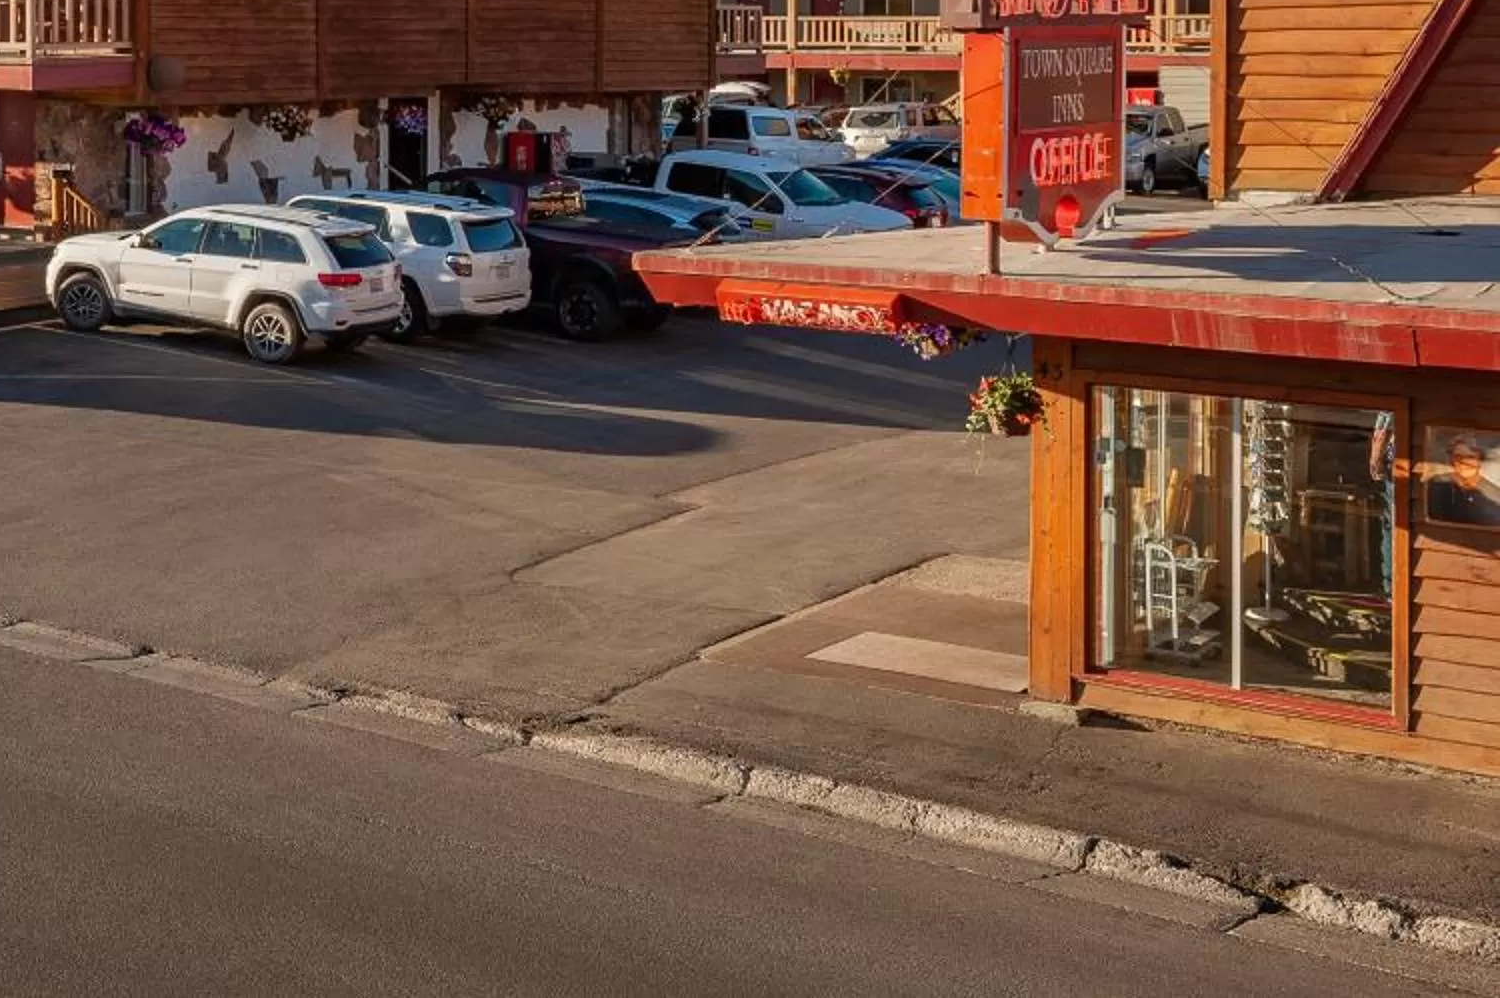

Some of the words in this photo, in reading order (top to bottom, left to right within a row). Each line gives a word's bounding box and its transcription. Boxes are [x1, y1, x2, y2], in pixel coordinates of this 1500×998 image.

[1021, 49, 1063, 79] TOWN
[1065, 46, 1114, 86] SQUARE
[1052, 93, 1085, 123] INNS
[1029, 132, 1113, 187] OFFICE
[761, 297, 892, 332] VACANCY
